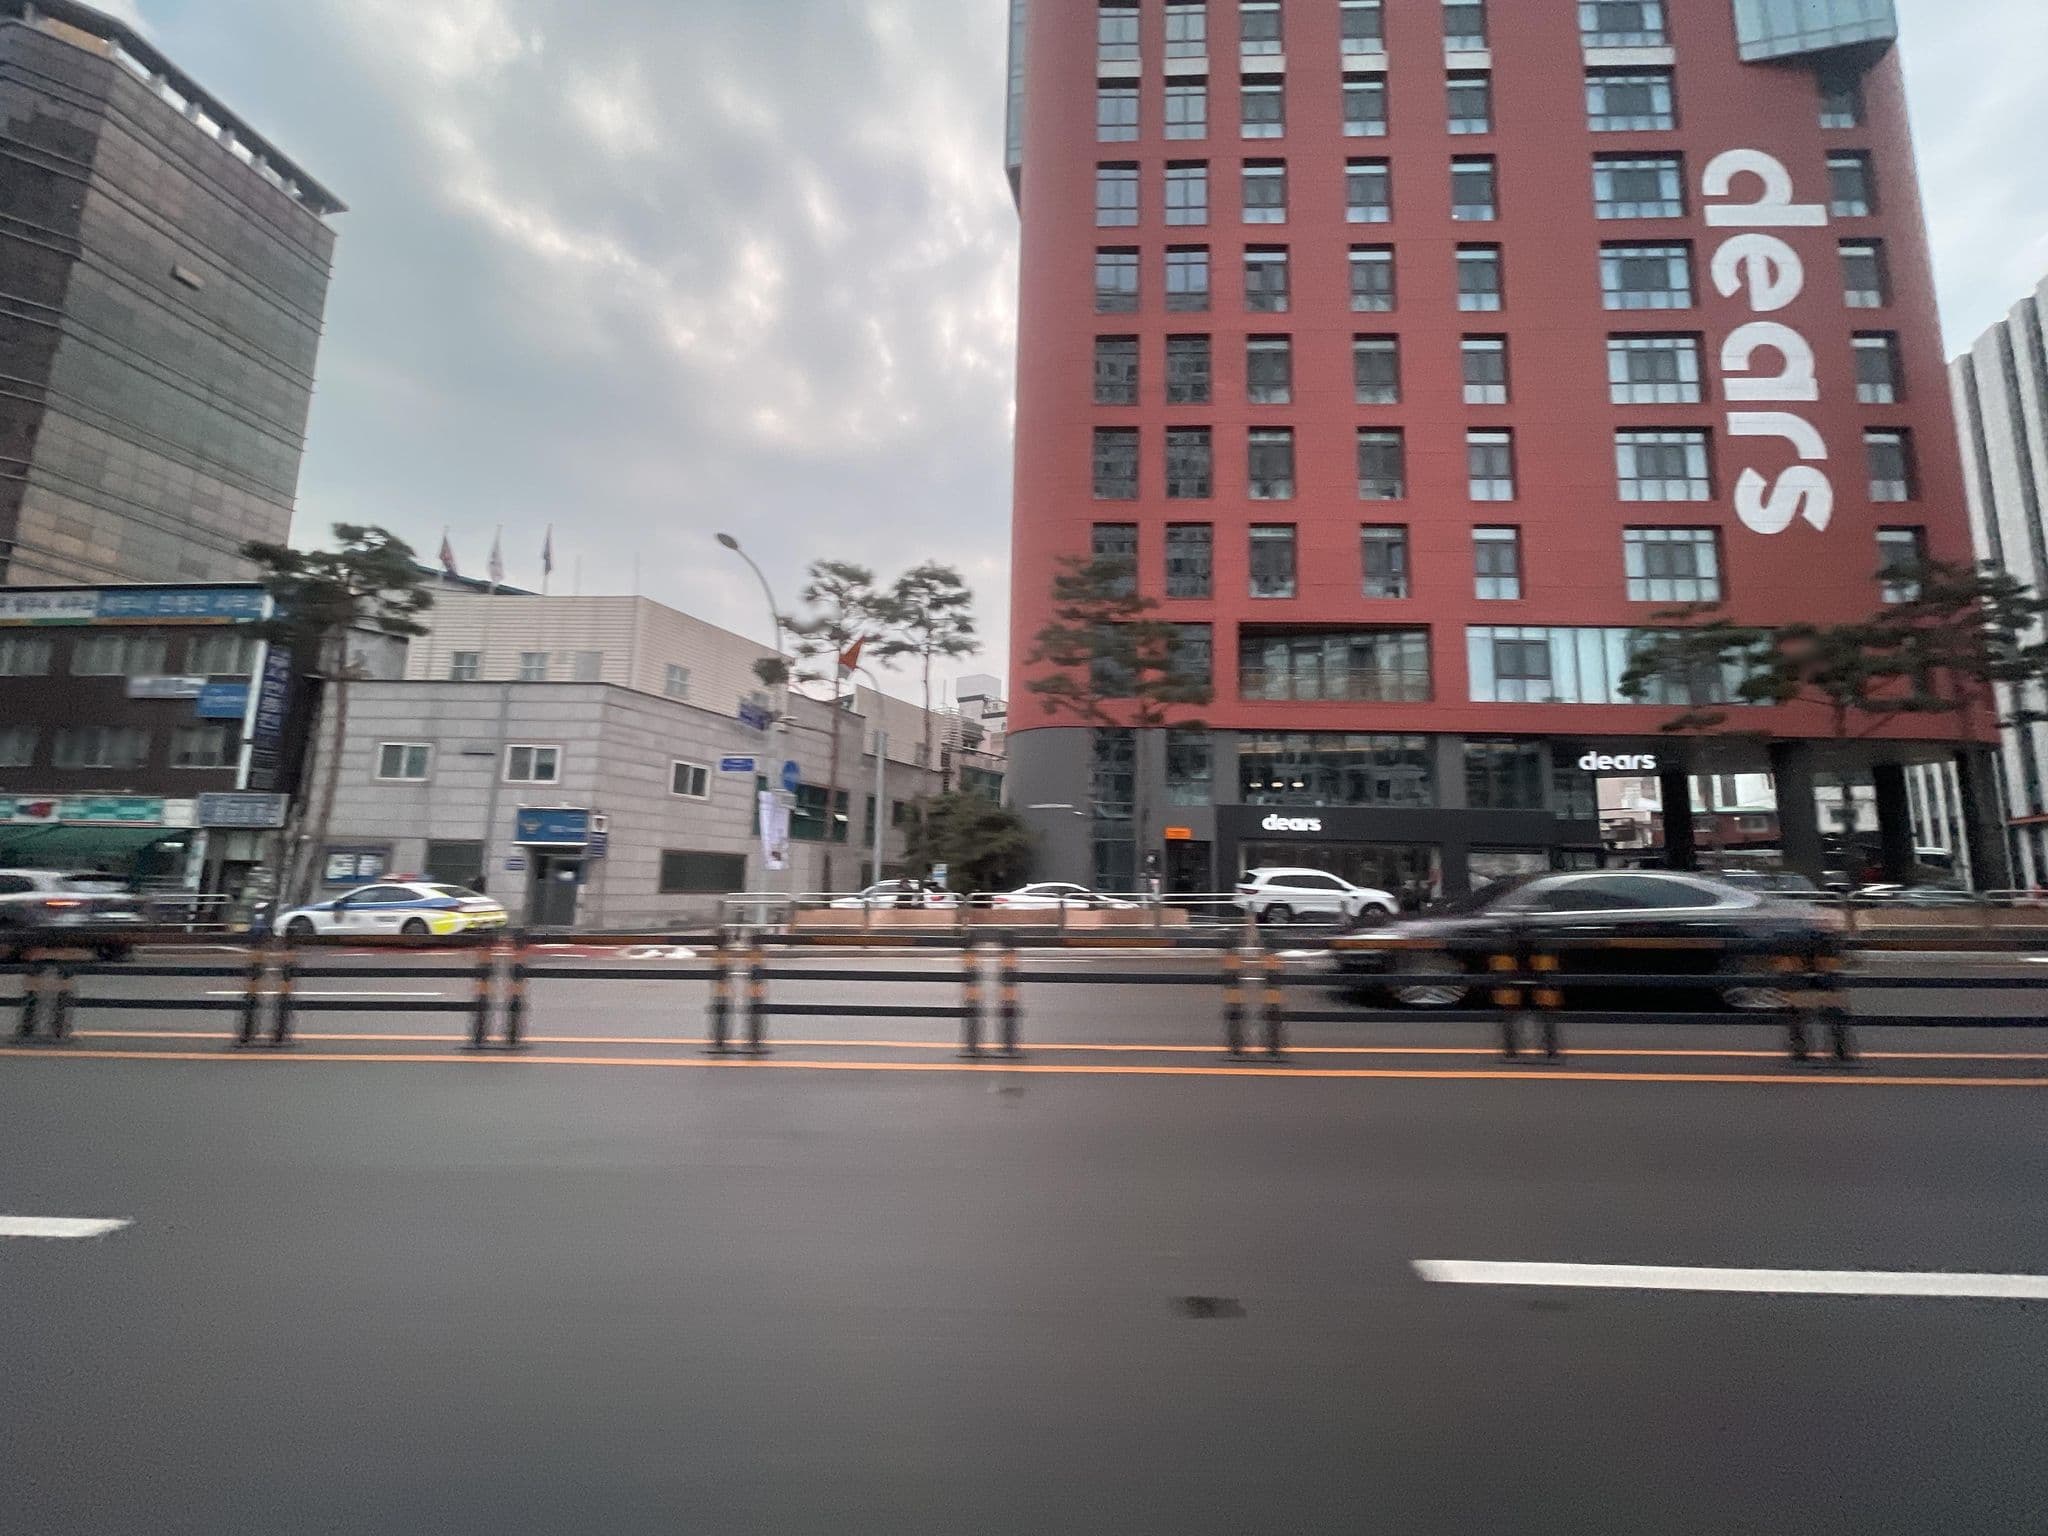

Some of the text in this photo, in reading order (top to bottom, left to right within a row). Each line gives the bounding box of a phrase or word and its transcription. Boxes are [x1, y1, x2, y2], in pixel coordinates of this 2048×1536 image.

[1702, 149, 1833, 534] dears
[1578, 751, 1657, 770] dears
[1262, 813, 1321, 831] dears
